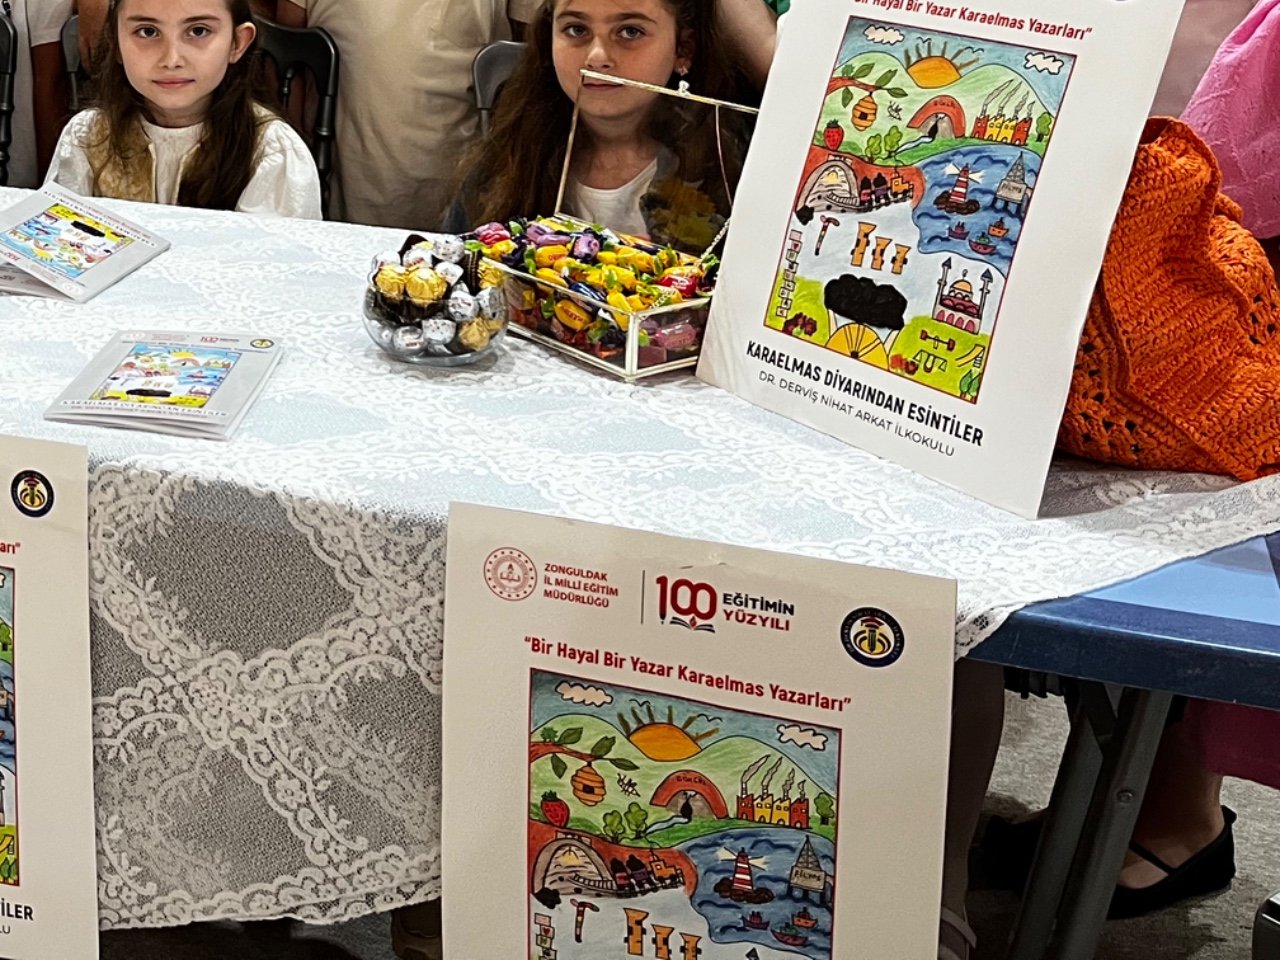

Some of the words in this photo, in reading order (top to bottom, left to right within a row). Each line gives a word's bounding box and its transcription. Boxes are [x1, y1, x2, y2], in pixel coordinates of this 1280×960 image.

[925, 1, 957, 18] Yazar
[958, 7, 1025, 29] Karaelmas
[746, 340, 821, 382] KARAELMAS
[824, 369, 905, 415] DİYARINDAN
[908, 402, 983, 447] ESİNTİLER
[758, 370, 776, 386] DR.
[779, 378, 818, 404] DERVİŞ
[820, 394, 854, 415] NİHAT
[855, 409, 893, 431] ARKAT
[895, 421, 955, 456] İLKOKULU
[543, 562, 608, 581] ZONGULDAK
[543, 575, 556, 586] İL
[558, 577, 581, 591] MİLLİ
[583, 579, 619, 596] EĞİTİM
[655, 576, 718, 621] 100
[543, 589, 609, 609] MÜDÜRLÜĞÜ
[722, 592, 795, 616] EĞİTİMİN
[722, 608, 790, 631] YÜZYILI
[557, 643, 599, 666] Hayal
[604, 652, 626, 669] Bir
[630, 656, 673, 677] Yazar
[677, 666, 764, 697] Karaelmas
